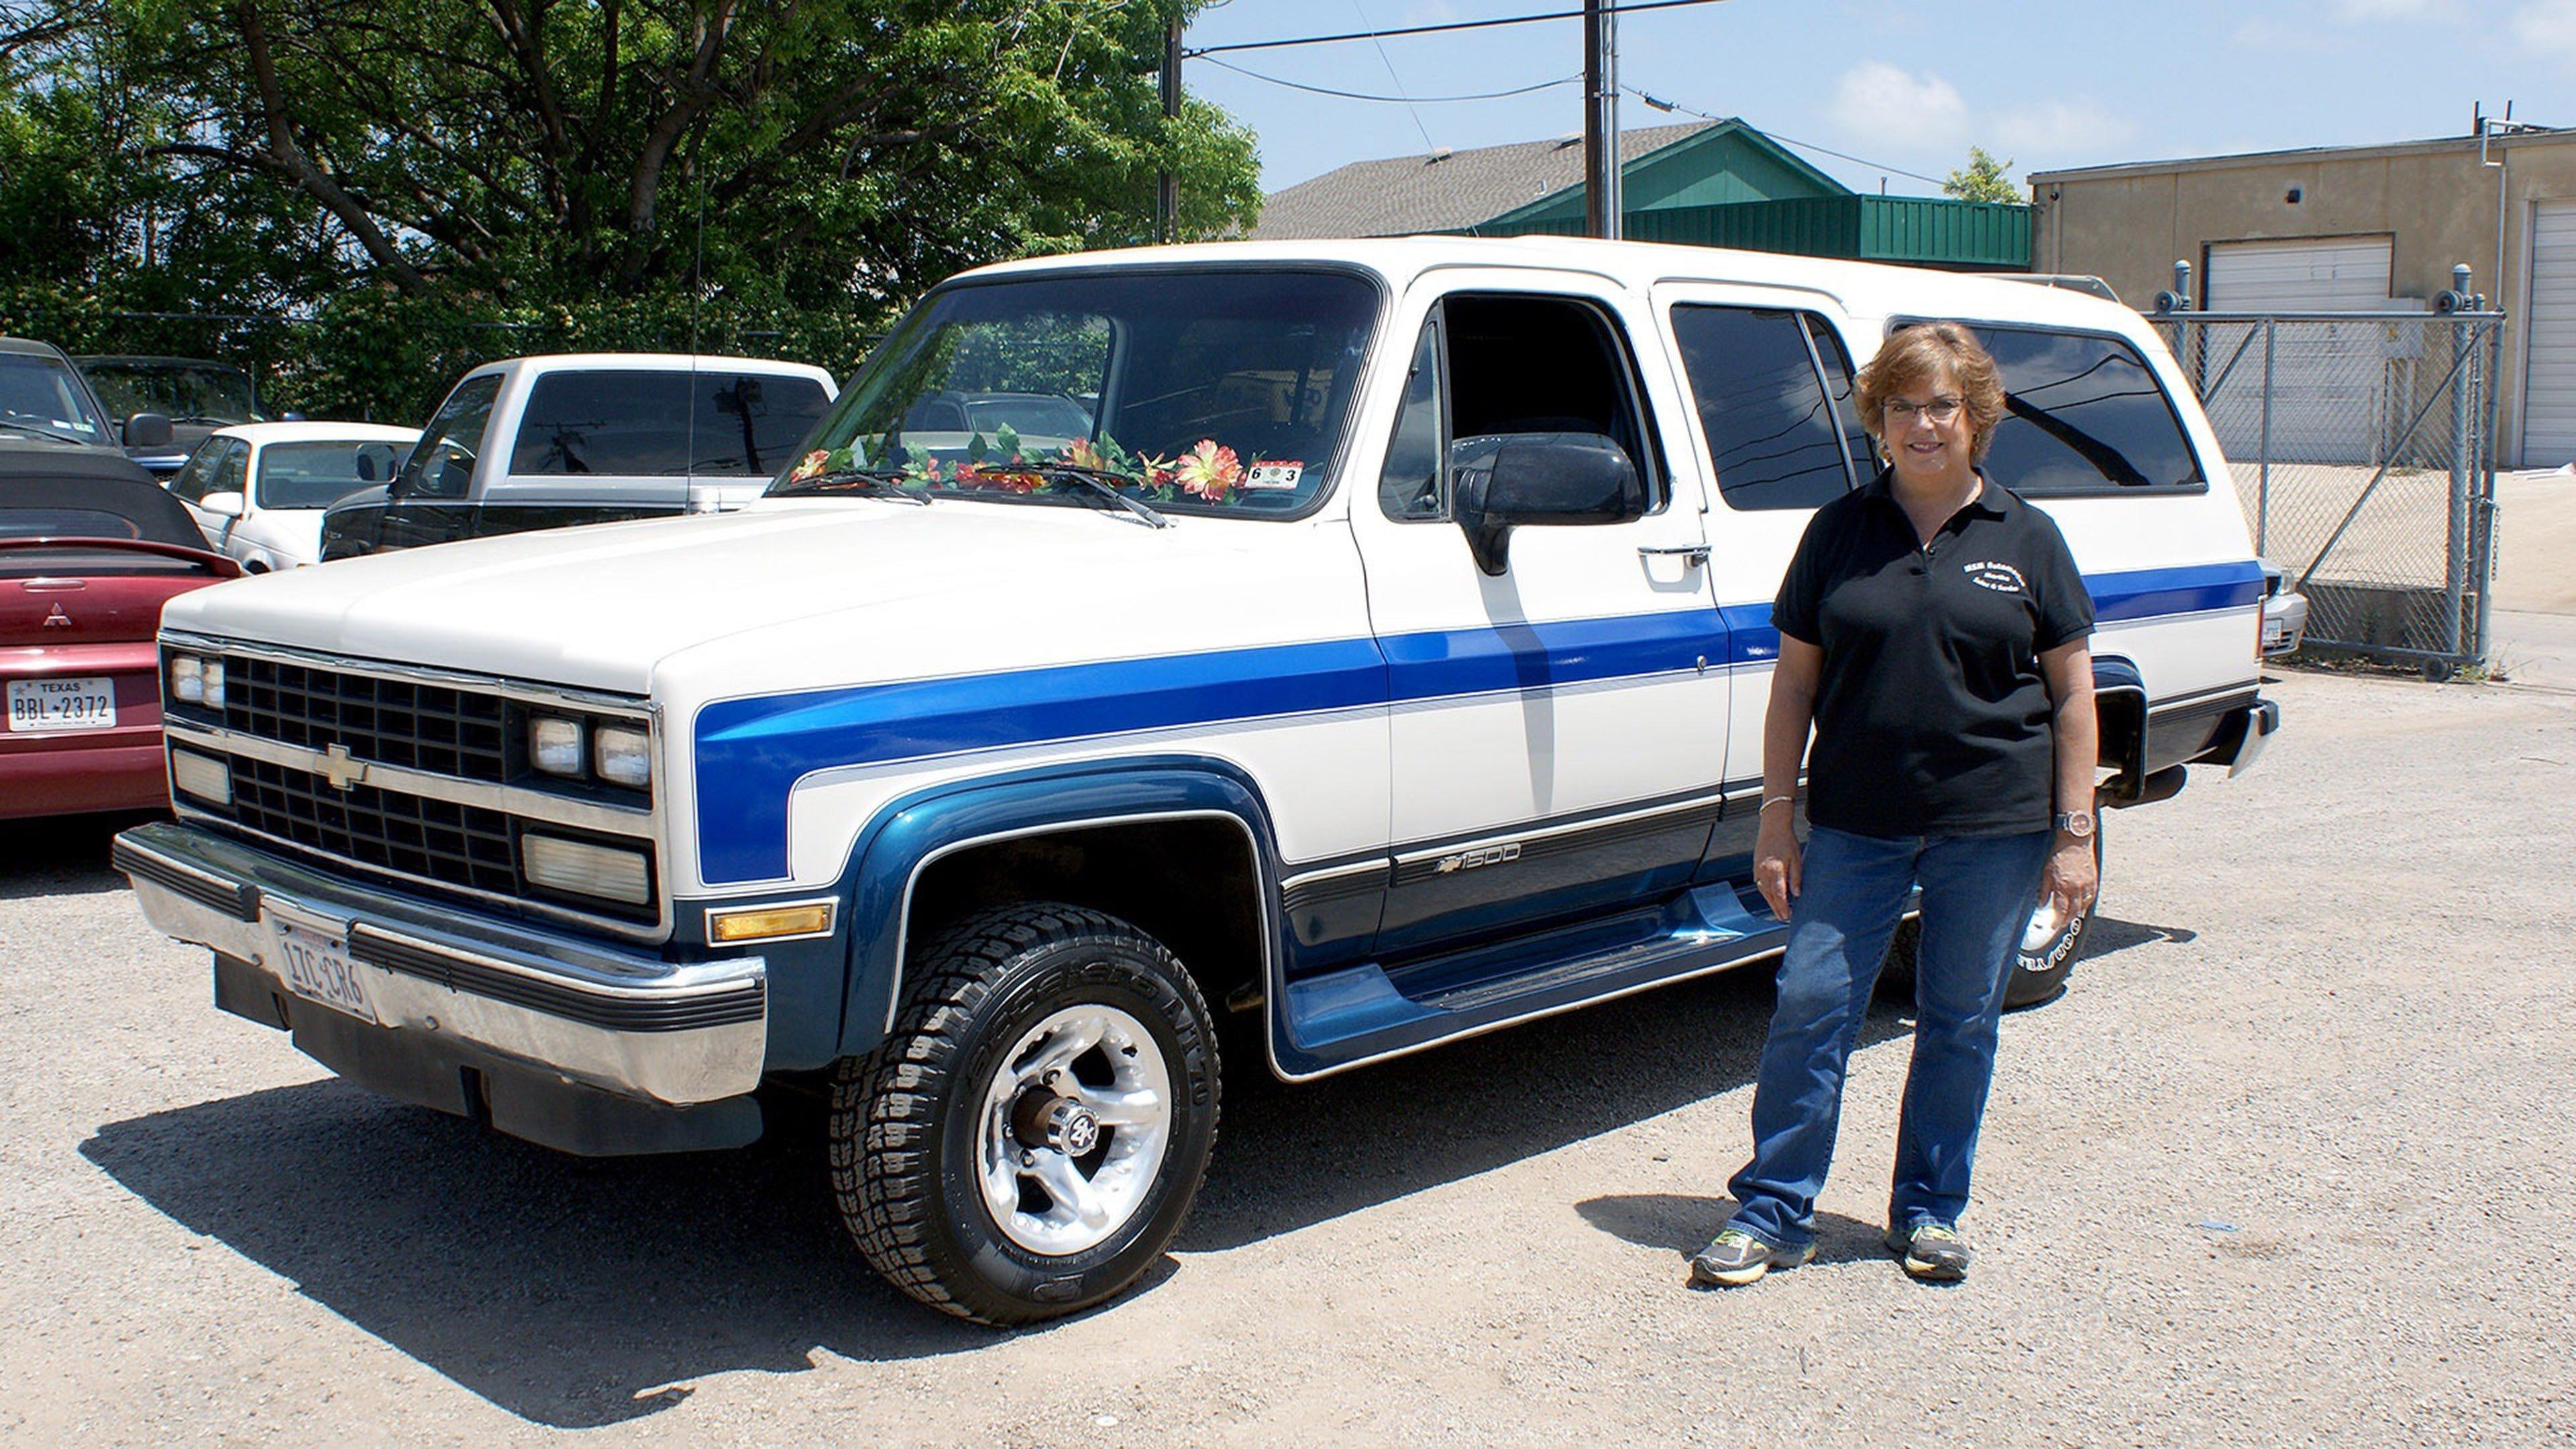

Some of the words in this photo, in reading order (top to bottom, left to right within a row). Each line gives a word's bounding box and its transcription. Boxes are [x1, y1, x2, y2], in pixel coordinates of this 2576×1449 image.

[1251, 468, 1262, 480] 6
[1285, 470, 1296, 482] 3
[41, 682, 81, 693] TEXAS
[1461, 842, 1521, 869] 1500
